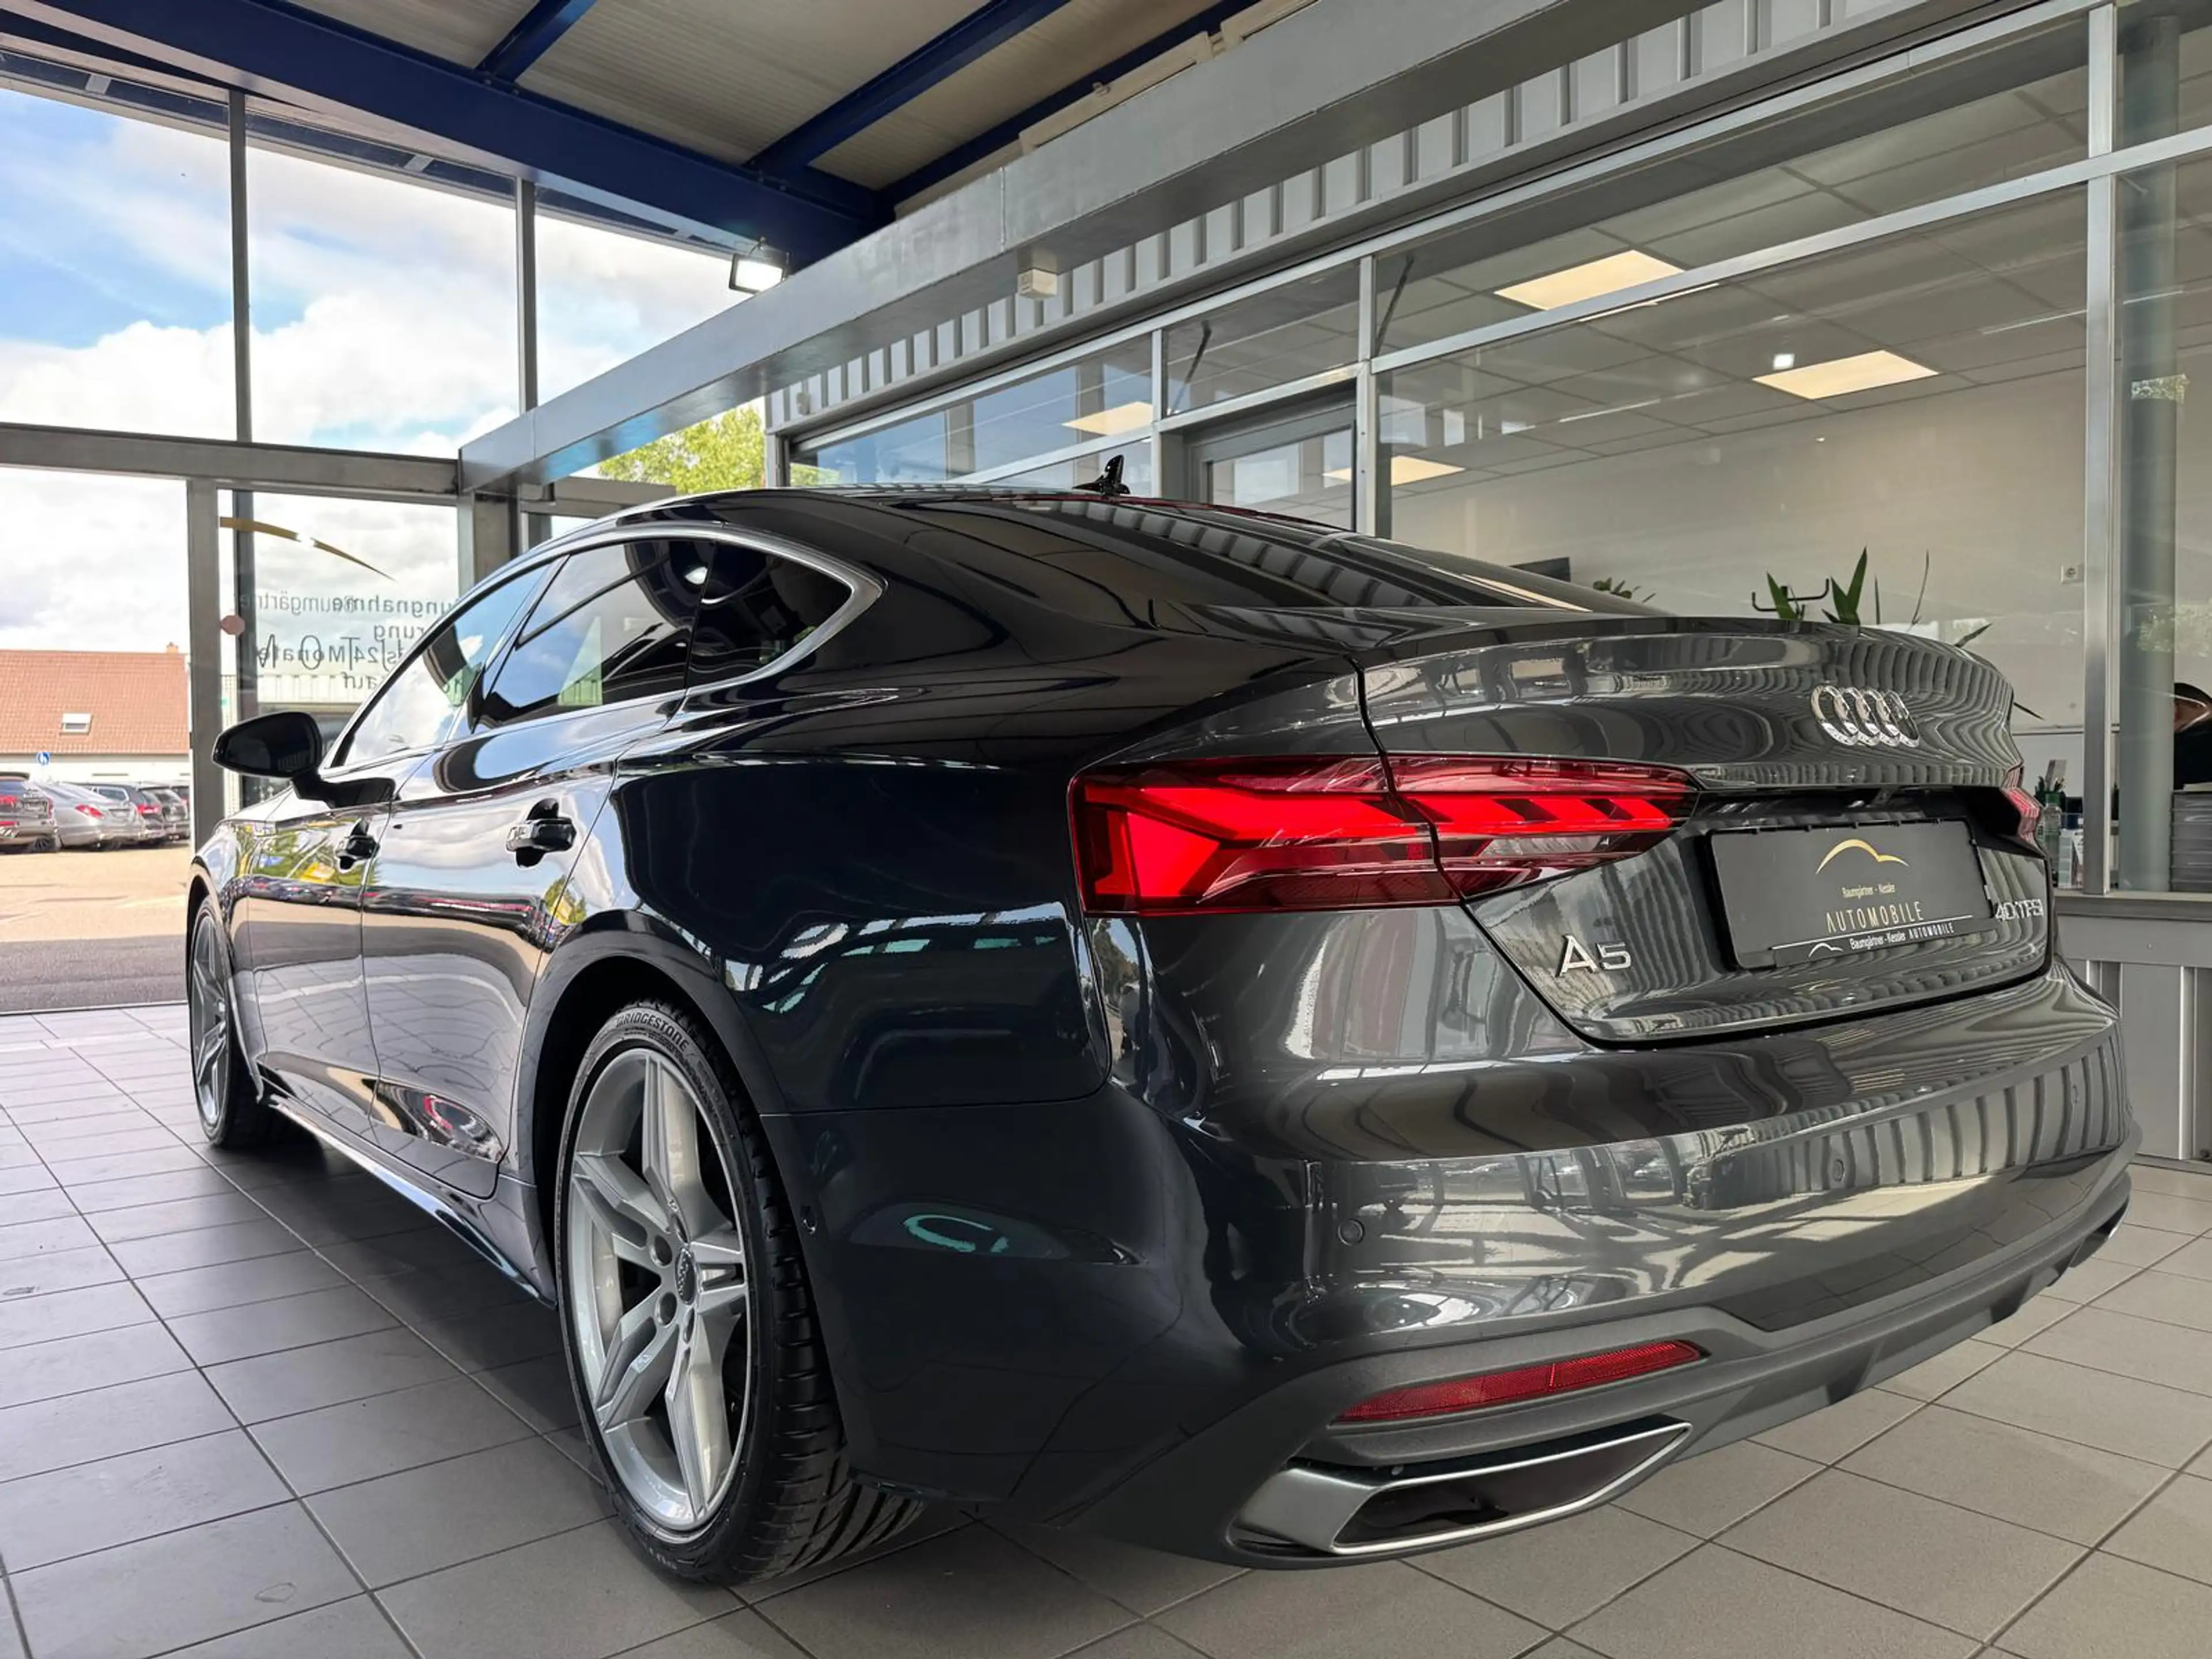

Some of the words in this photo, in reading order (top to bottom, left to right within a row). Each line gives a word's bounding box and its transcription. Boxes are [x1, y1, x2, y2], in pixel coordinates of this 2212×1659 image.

[1825, 901, 1924, 933] AUTOMOBILE
[1908, 923, 1955, 940] AUTOMOBILE
[1558, 934, 1631, 976] A5
[616, 1012, 690, 1052] BRIDGESTONE
